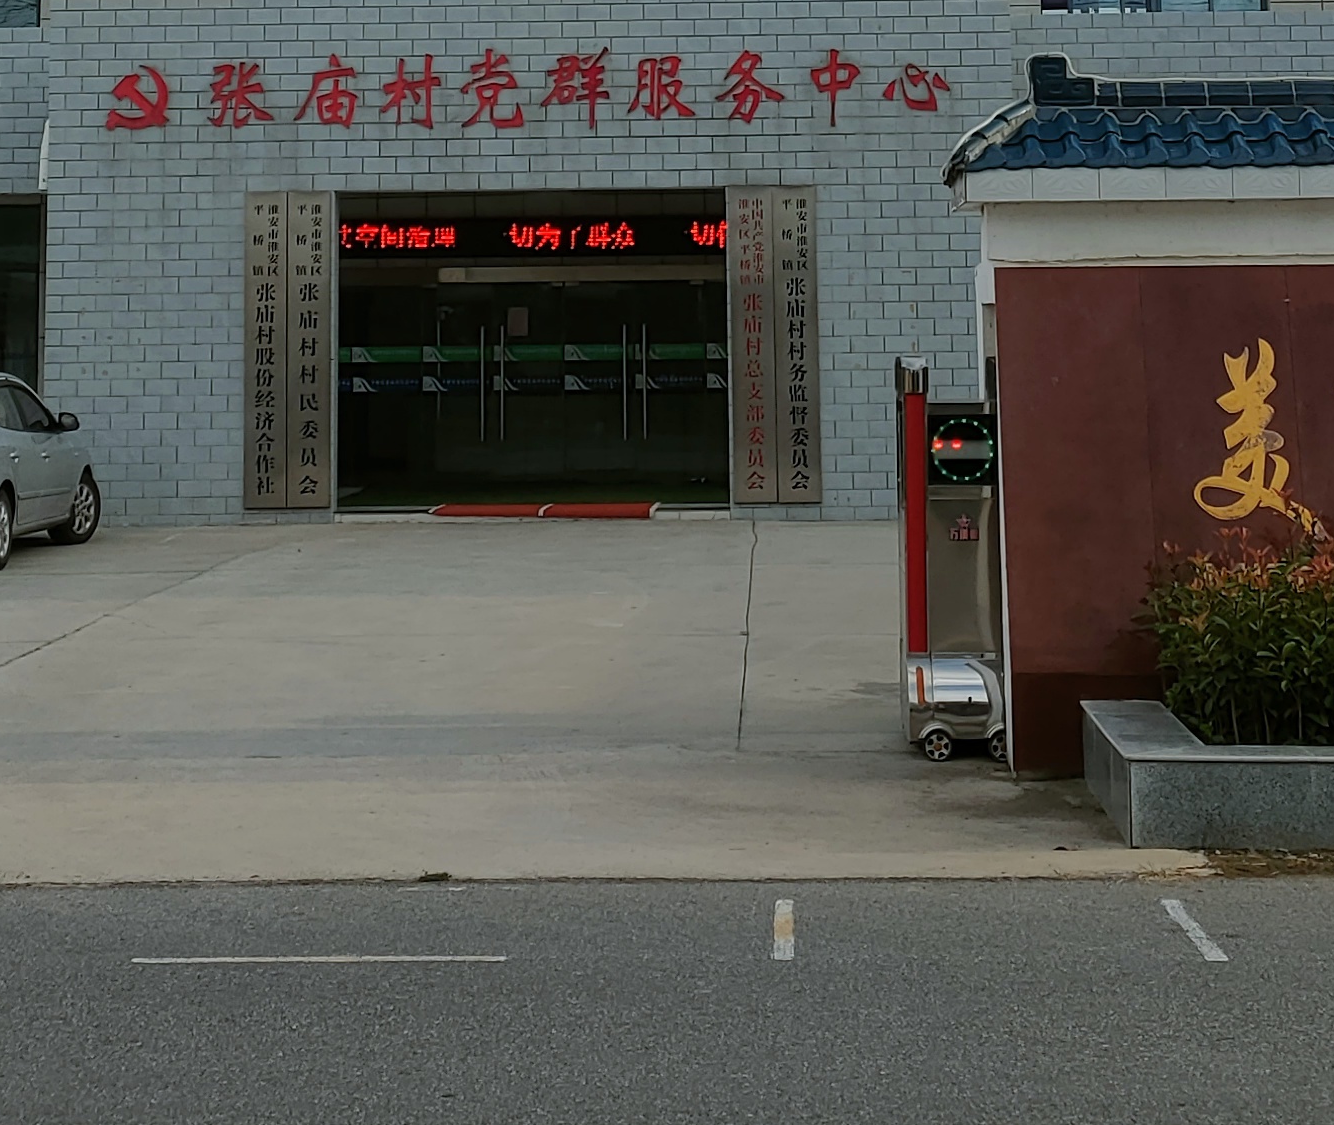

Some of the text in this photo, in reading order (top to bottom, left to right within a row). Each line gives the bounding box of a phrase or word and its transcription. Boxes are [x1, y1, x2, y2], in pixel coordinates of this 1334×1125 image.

[208, 46, 952, 130] 张庙村党群服务中心
[254, 282, 276, 496] 张庙村股份经济合作社
[298, 282, 319, 495] 张庙村村民委员会
[743, 292, 766, 491] 张庙村总支部委员会
[785, 276, 810, 491] 张庙村村务监督委员会
